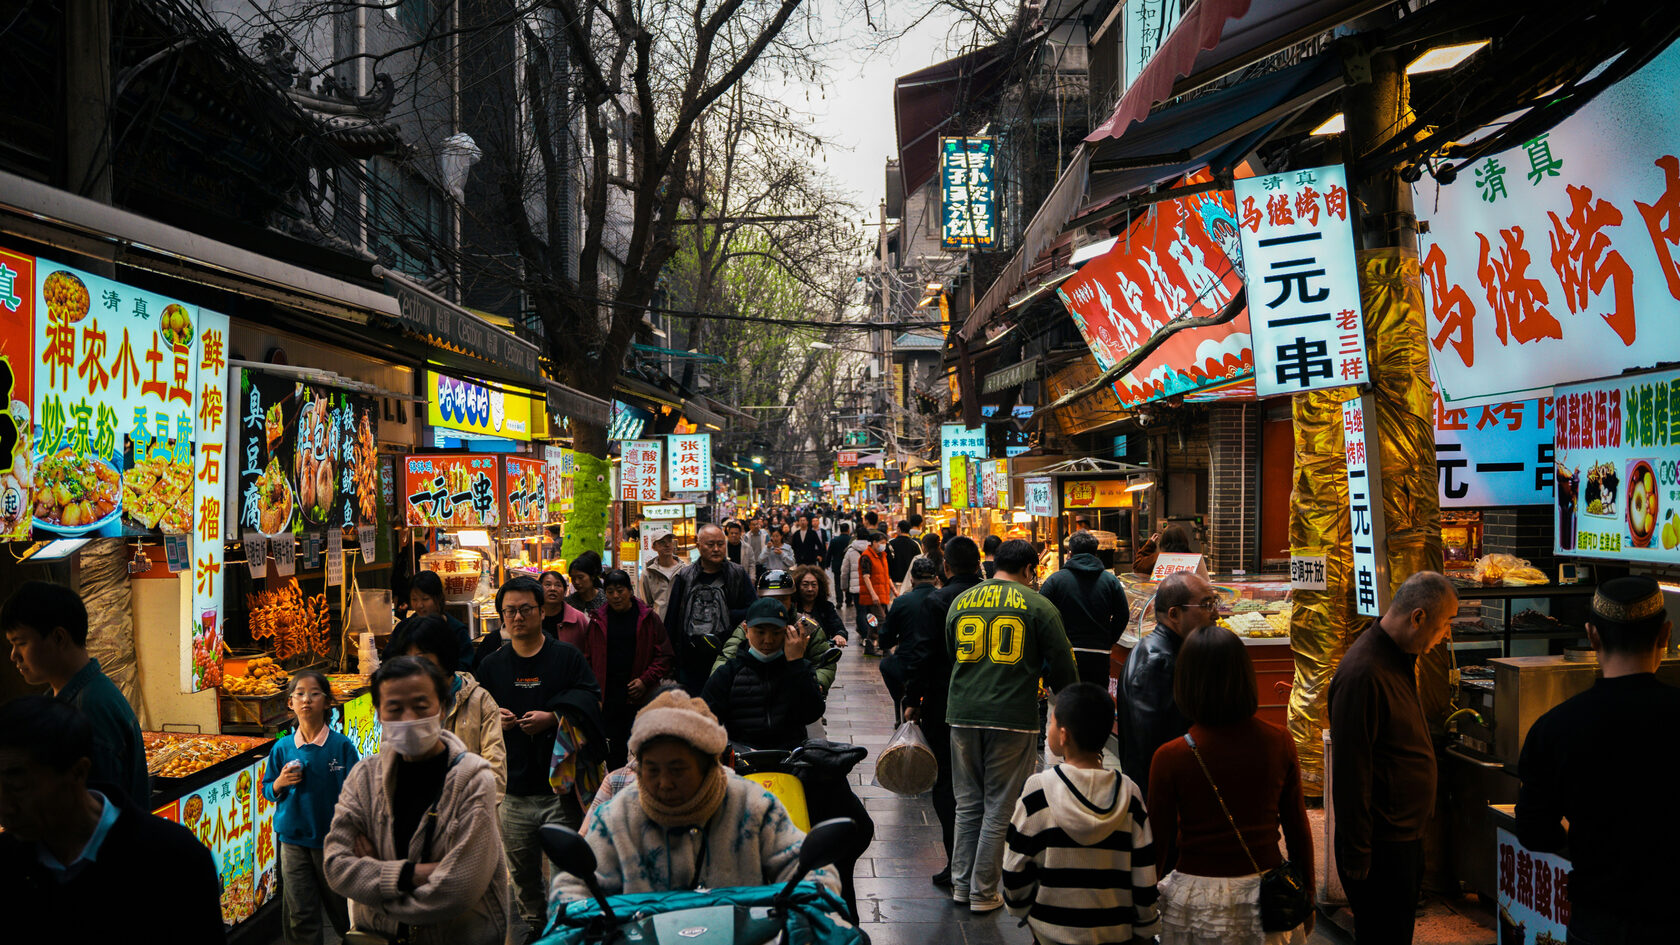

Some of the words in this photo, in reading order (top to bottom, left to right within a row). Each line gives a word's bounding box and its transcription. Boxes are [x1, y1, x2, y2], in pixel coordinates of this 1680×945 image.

[1262, 170, 1317, 191] 清真
[1475, 132, 1563, 203] 清真
[1239, 184, 1347, 233] 马继烤肉
[102, 289, 150, 320] 清真
[1258, 231, 1334, 388] 一元一串
[42, 306, 193, 407] 神农小土豆
[1335, 309, 1364, 381] 老三样
[38, 393, 119, 462] 炒凉粉
[129, 405, 193, 465] 香豆腐
[297, 414, 338, 462] 肚包肉
[1556, 388, 1621, 450] 现熬酸梅汤
[198, 329, 225, 597] 鲜榨石榴汁
[241, 384, 265, 532] 臭豆腐
[471, 458, 492, 469] 清真
[641, 450, 656, 500] 酸汤水饺
[680, 440, 699, 488] 张庆烤肉
[408, 471, 493, 523] 一元一串
[508, 474, 545, 518] 一元一串
[1350, 470, 1376, 612] 一元一串
[957, 585, 1003, 610] GOLDEN
[1004, 587, 1028, 610] AGE
[1291, 560, 1325, 584] 空调开放
[956, 615, 1025, 665] 90
[207, 781, 231, 804] 清真
[222, 836, 253, 889] 香豆腐
